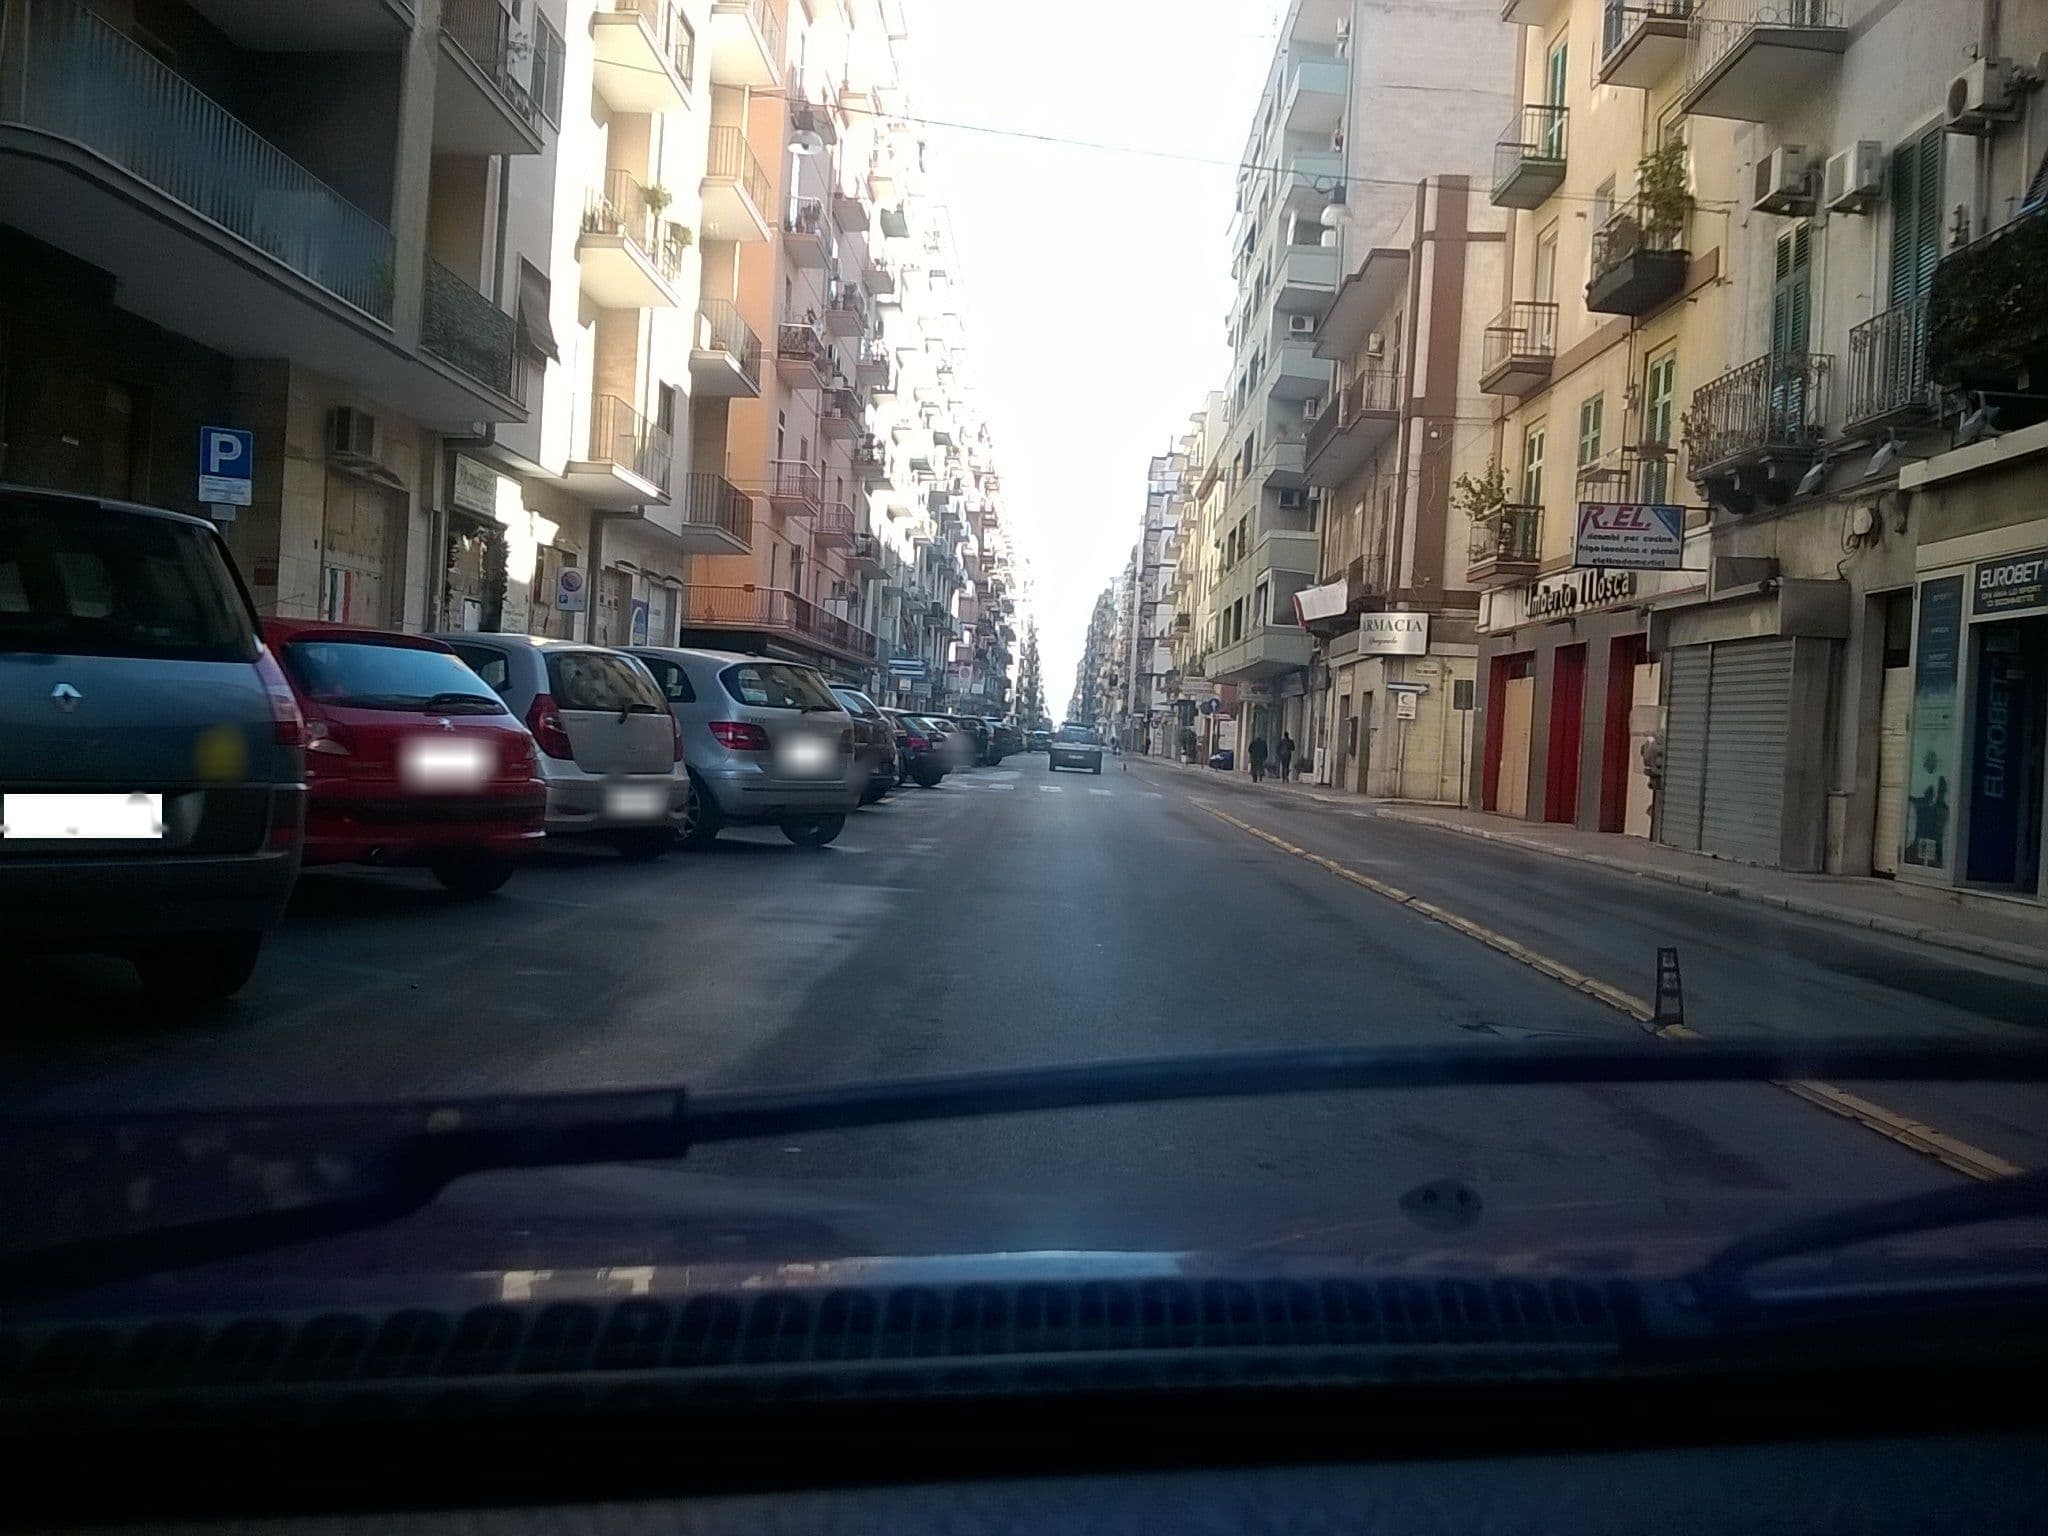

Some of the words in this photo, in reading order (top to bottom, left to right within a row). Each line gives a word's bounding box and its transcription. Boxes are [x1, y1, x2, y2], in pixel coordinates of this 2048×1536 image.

[210, 432, 242, 473] P
[1525, 582, 1574, 616] Umberto
[1577, 567, 1631, 605] Mosca
[1979, 560, 2044, 589] EUROBET
